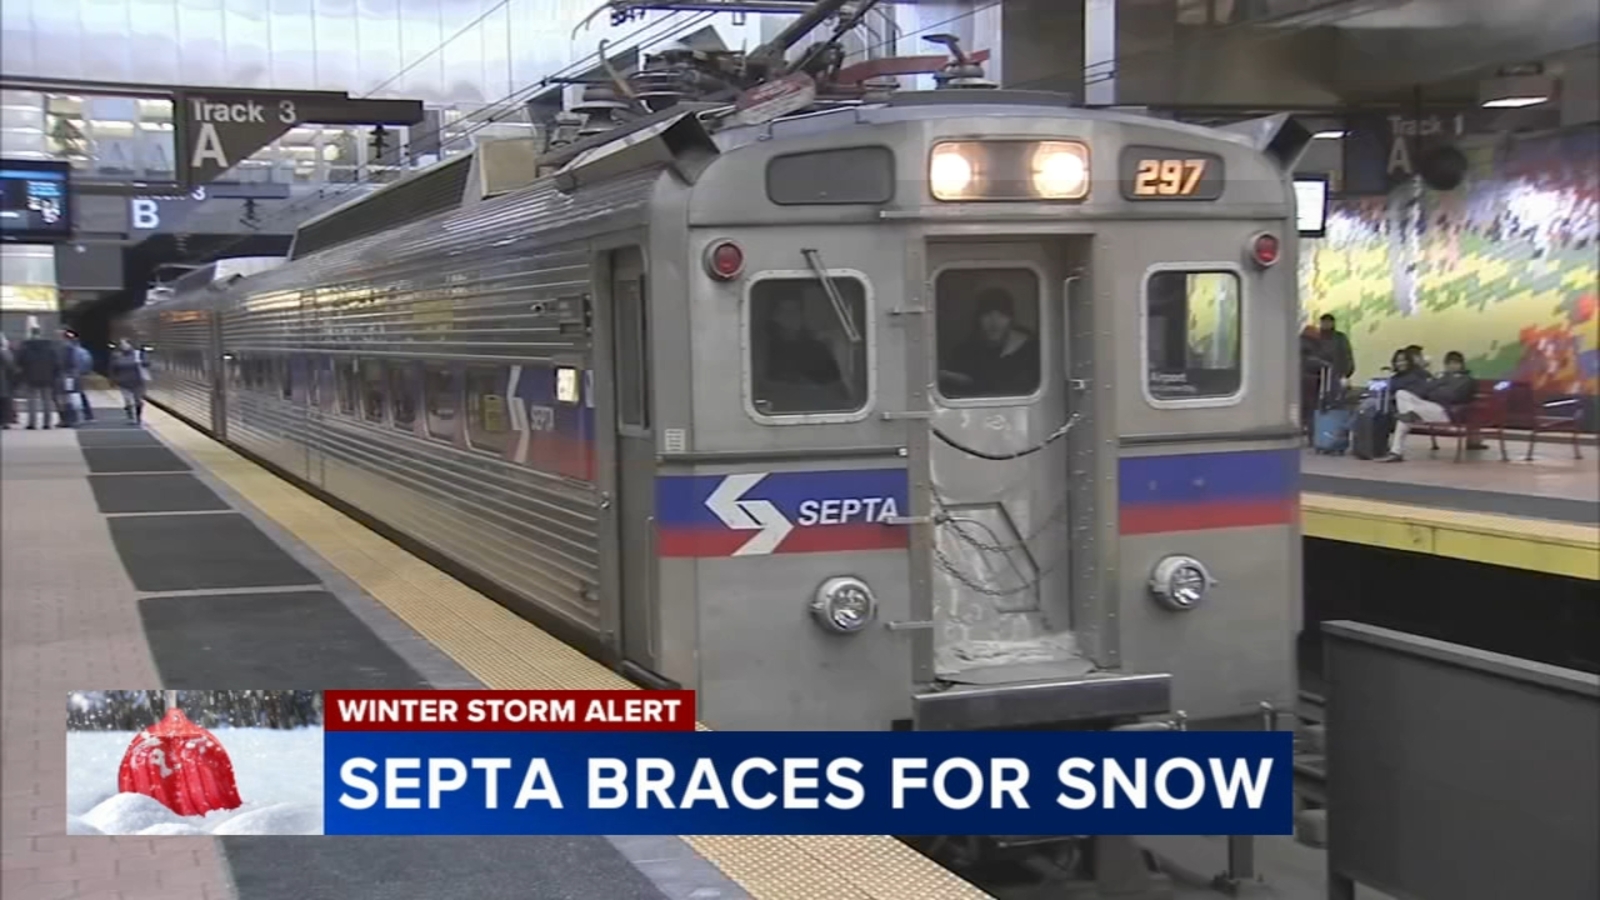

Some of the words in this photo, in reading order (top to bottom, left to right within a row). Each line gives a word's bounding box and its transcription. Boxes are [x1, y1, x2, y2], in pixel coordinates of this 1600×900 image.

[190, 98, 265, 123] Track
[279, 100, 296, 124] 3
[191, 122, 229, 168] A
[1387, 137, 1411, 174] A
[1133, 159, 1206, 195] 297
[132, 199, 160, 229] B
[798, 497, 899, 526] SEPTA
